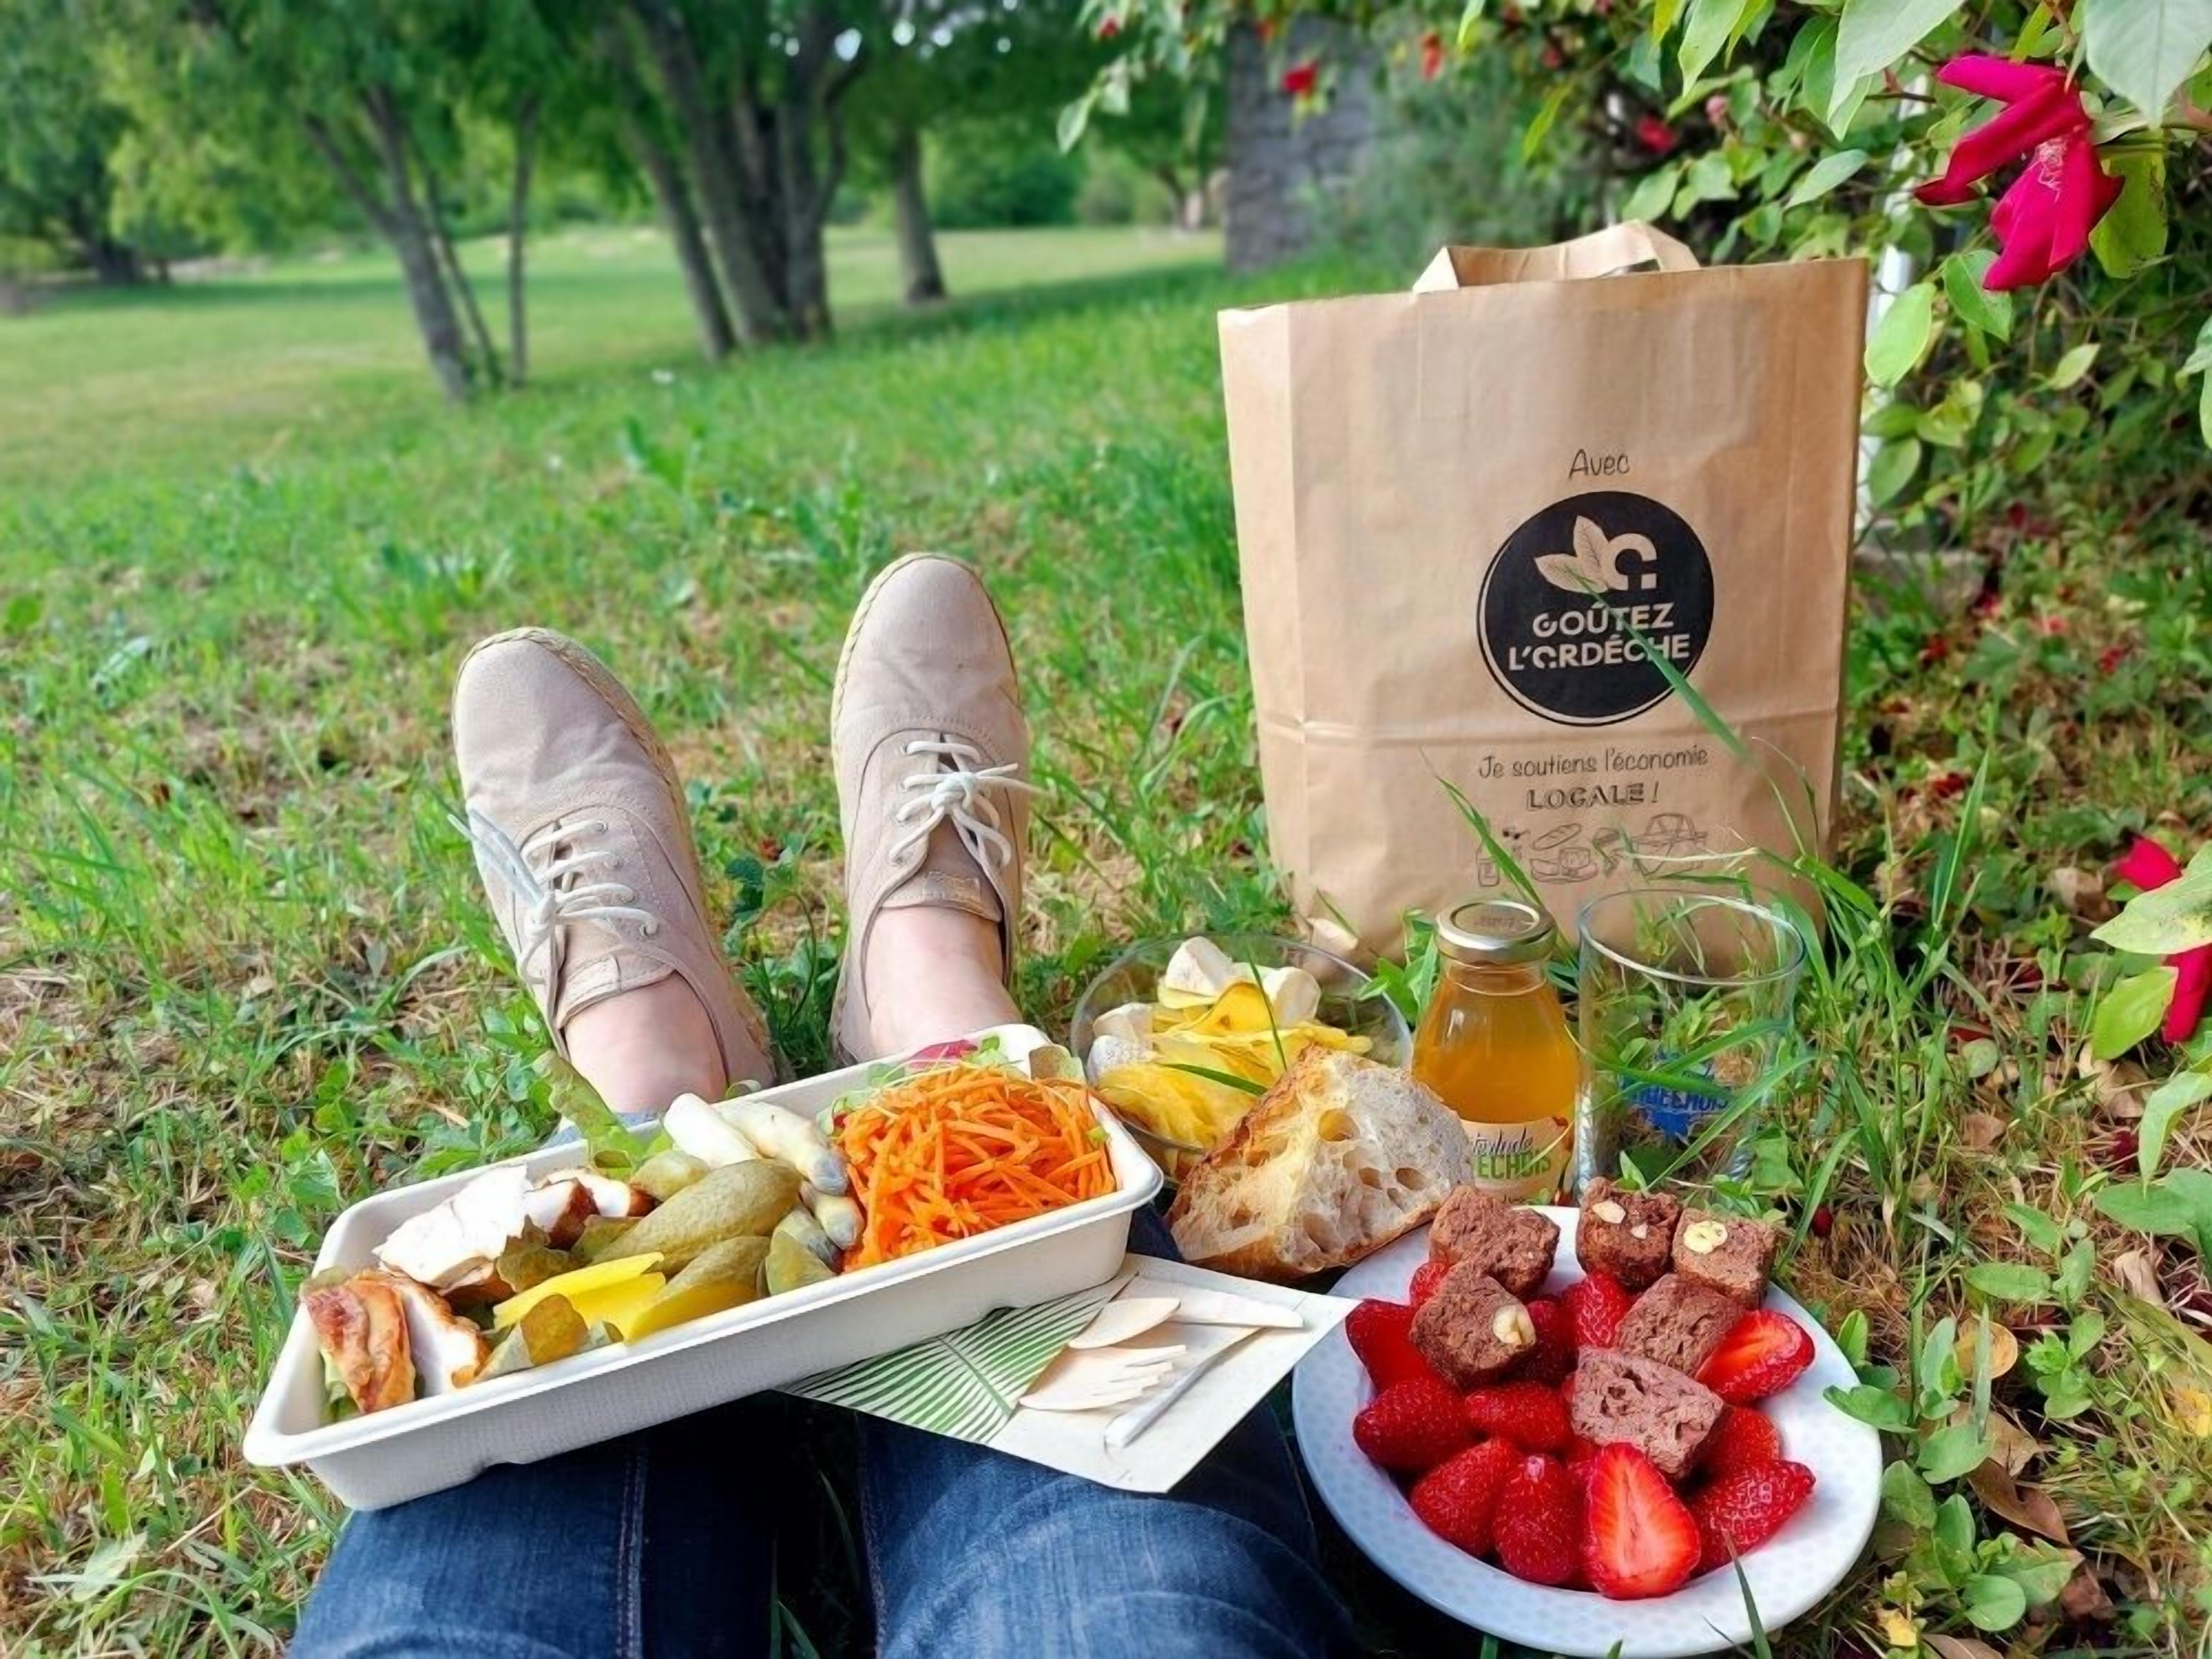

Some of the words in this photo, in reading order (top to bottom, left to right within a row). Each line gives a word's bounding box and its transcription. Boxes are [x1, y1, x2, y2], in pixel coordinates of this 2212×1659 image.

[1568, 448, 1630, 479] Avec
[1532, 602, 1674, 638] GOÛTEZ
[1479, 755, 1504, 779] Je
[1512, 754, 1598, 777] soutiens
[1605, 744, 1709, 772] l'économie
[1651, 781, 1659, 803] !
